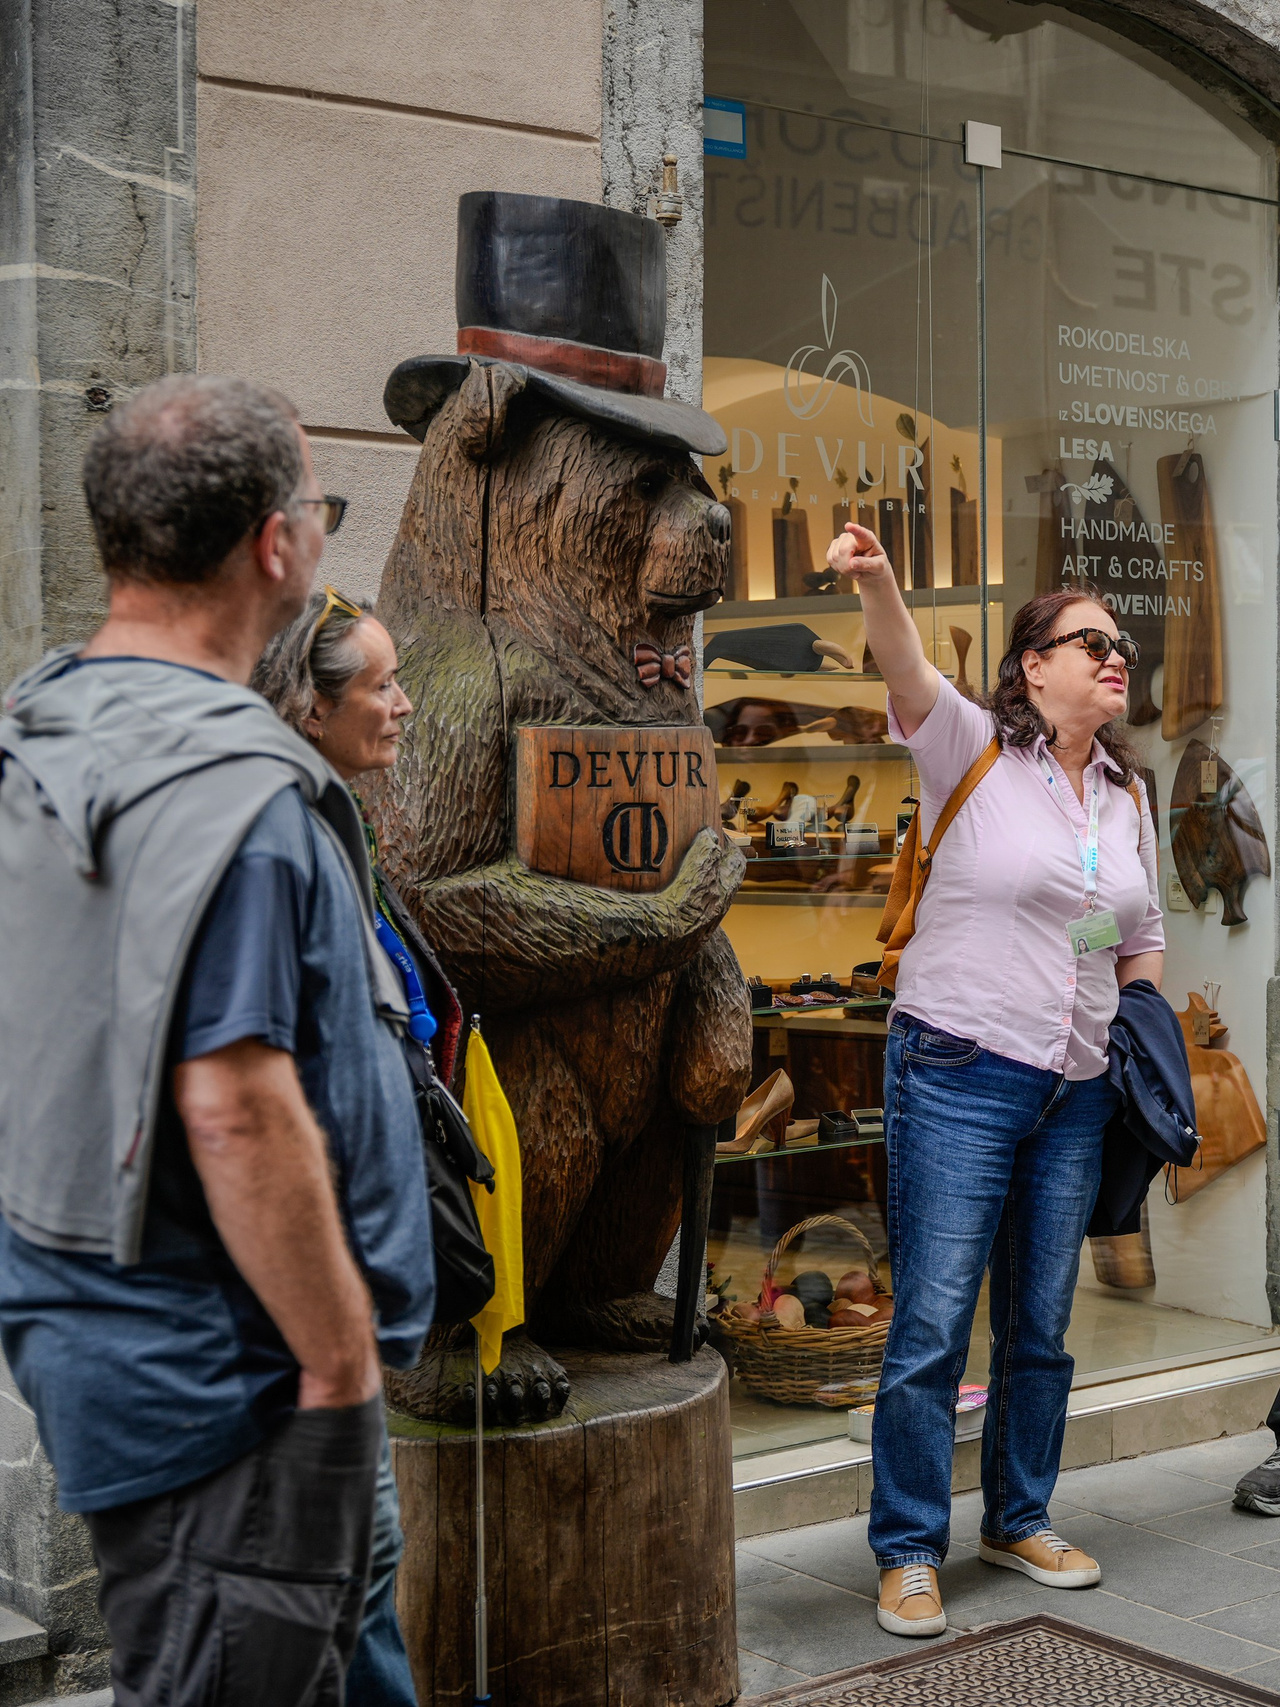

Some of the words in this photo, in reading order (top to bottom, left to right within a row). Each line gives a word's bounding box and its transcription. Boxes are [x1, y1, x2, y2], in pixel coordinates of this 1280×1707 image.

[1058, 324, 1191, 361] ROKODELSKA
[1058, 363, 1170, 394] UMETNOST
[1176, 374, 1190, 397] &
[1071, 400, 1217, 436] SLOVENSKEGA
[731, 427, 925, 491] DEVUR
[1059, 436, 1115, 463] LESA
[732, 487, 818, 505] DEJAN
[841, 496, 926, 514] HRIBAR
[1060, 517, 1176, 546] HANDMADE
[1061, 554, 1102, 577] ART
[1108, 555, 1123, 579] &
[1127, 557, 1205, 583] CRAFTS
[1103, 592, 1192, 617] OVENIAN
[549, 751, 707, 788] DEVUR
